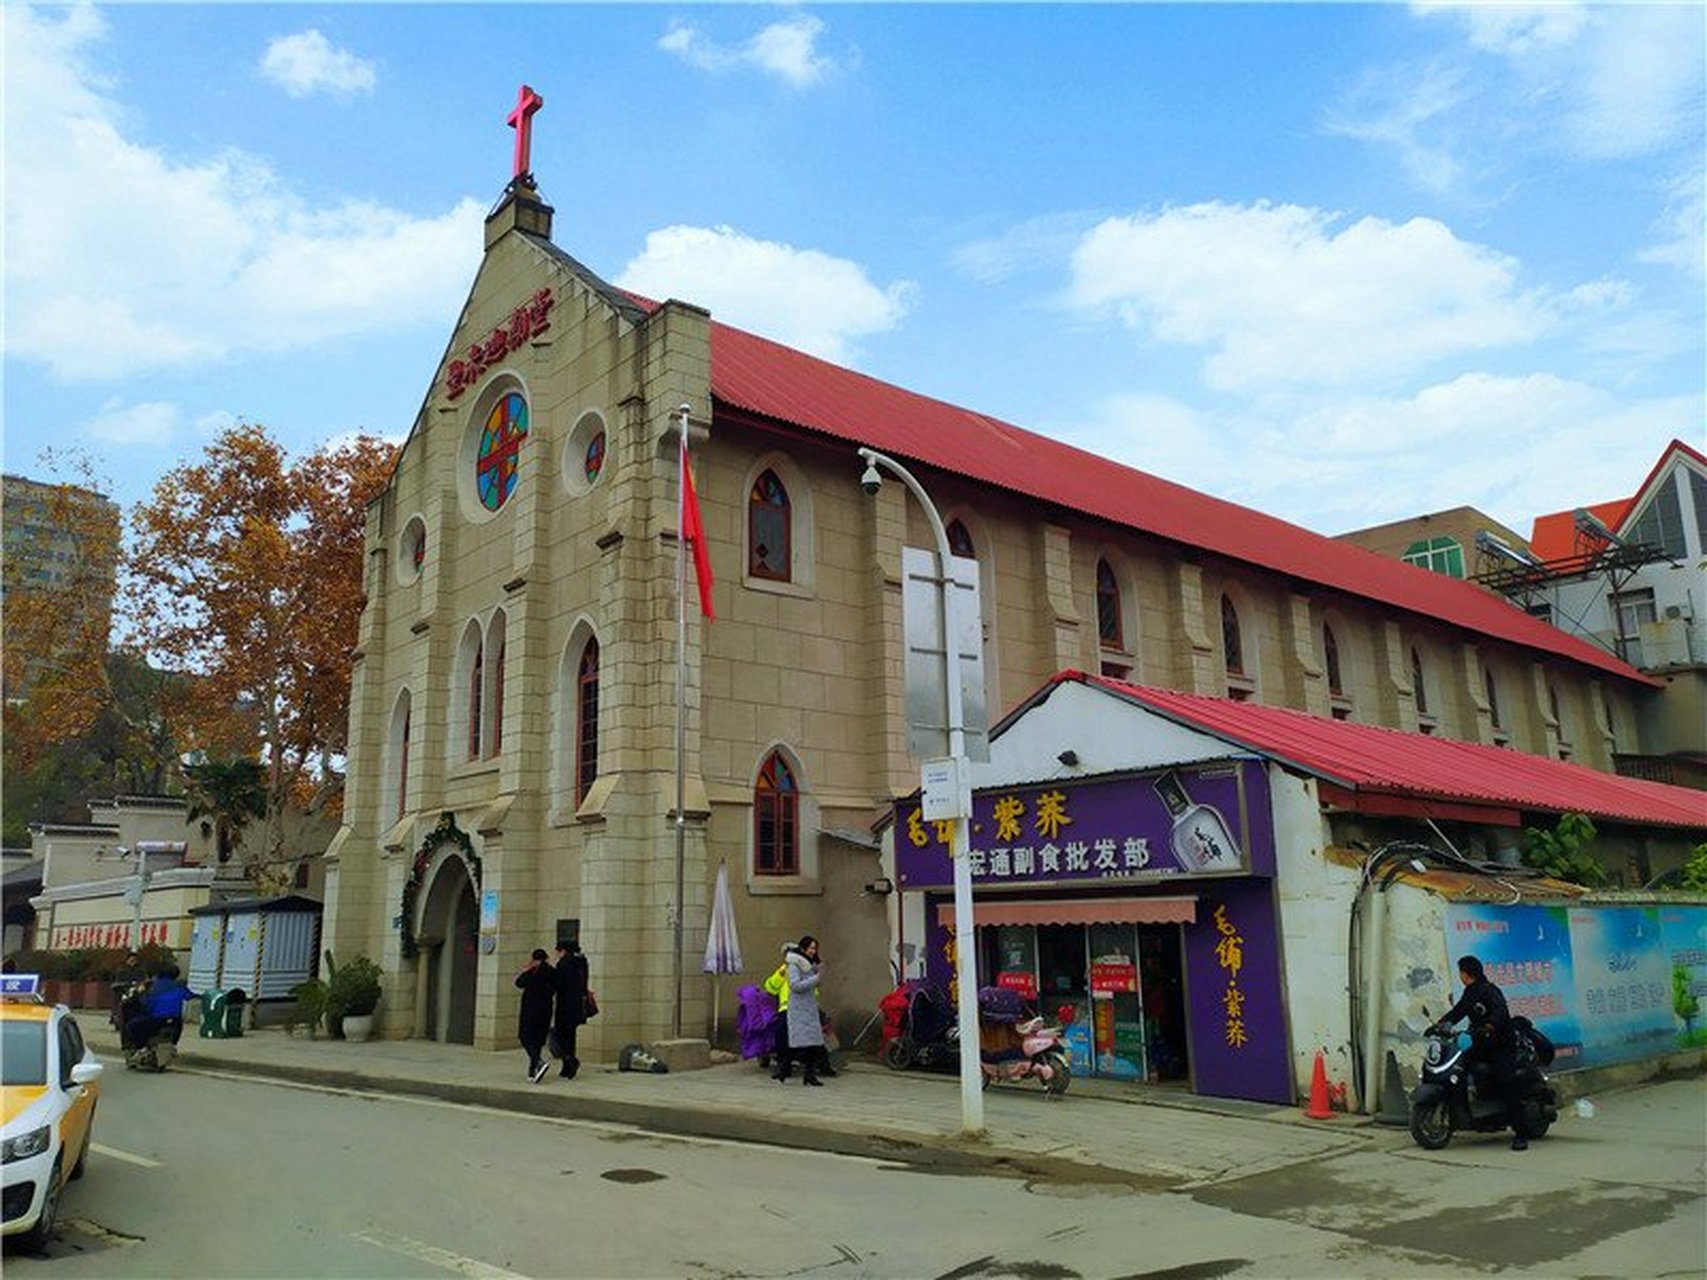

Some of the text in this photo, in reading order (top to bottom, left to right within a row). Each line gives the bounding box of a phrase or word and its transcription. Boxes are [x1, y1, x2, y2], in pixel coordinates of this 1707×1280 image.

[969, 837, 1150, 876] 宏通副食批发部
